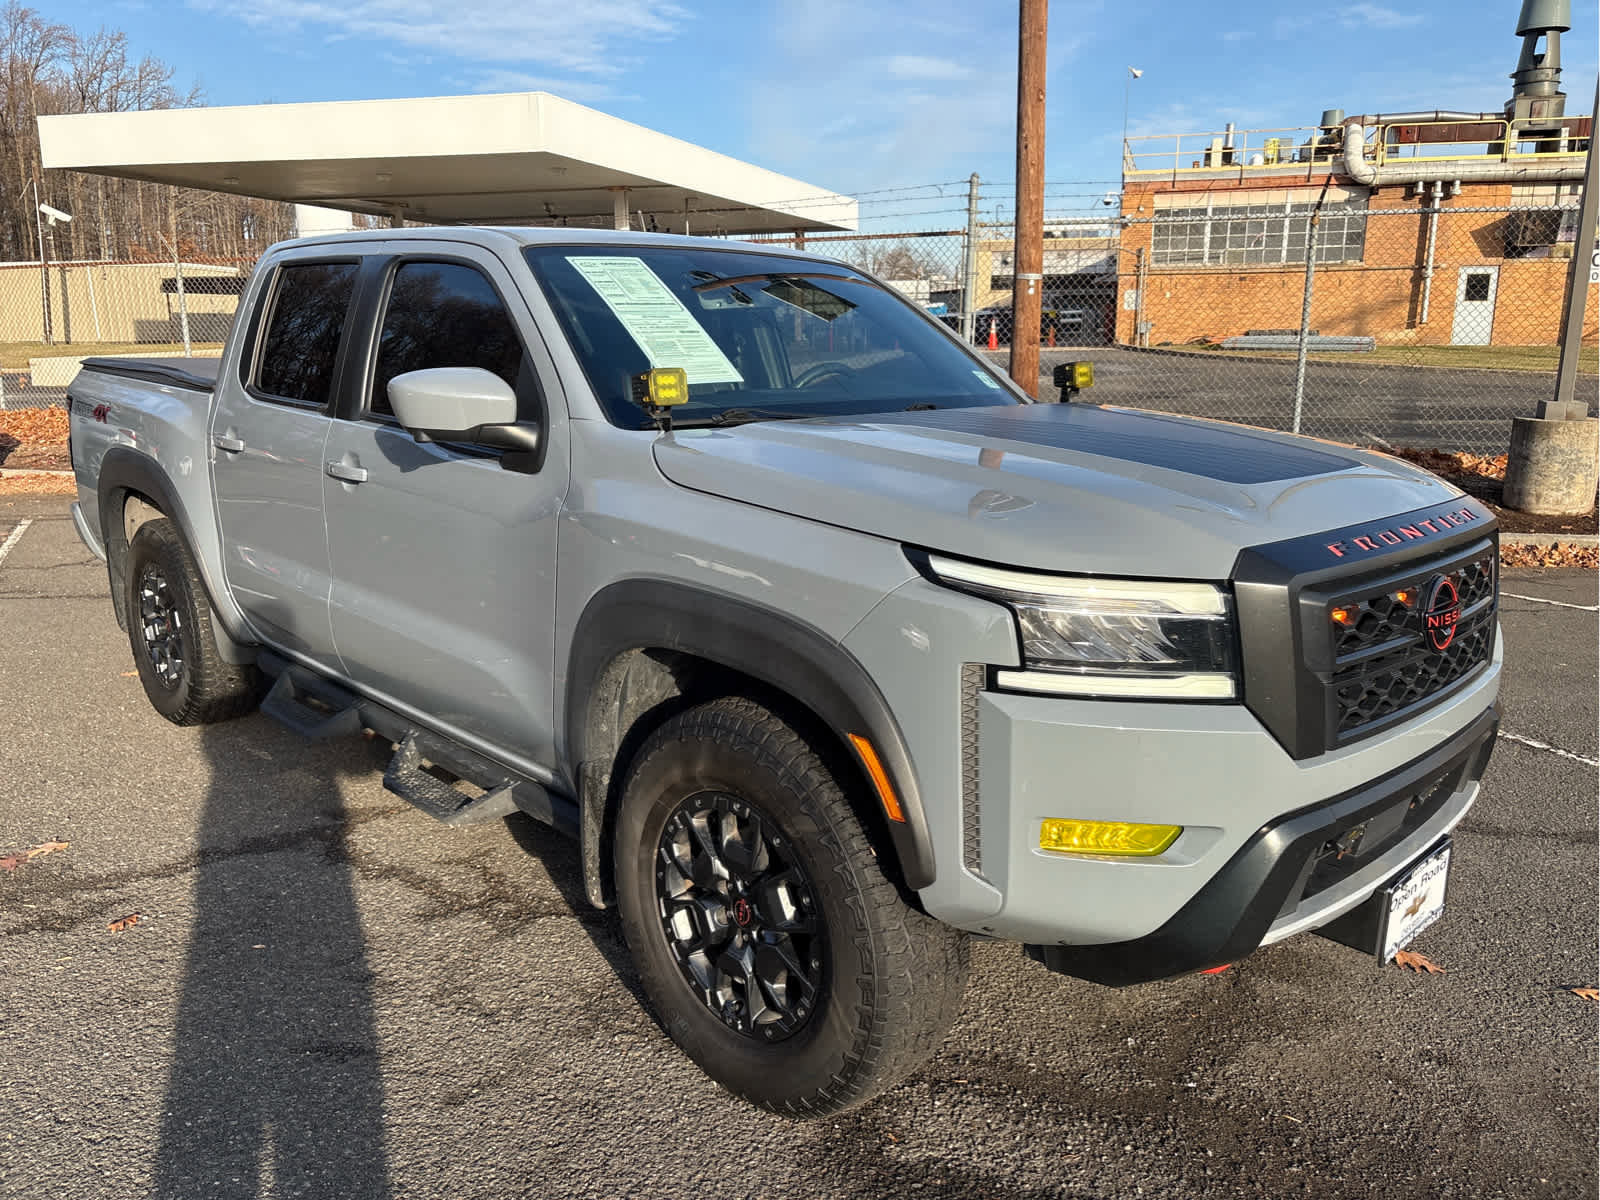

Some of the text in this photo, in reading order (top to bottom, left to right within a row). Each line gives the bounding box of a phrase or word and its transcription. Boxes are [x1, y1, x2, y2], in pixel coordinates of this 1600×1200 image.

[1327, 507, 1479, 557] FRONTIER
[1427, 608, 1461, 628] NISS
[1390, 883, 1418, 912] Open
[1420, 860, 1447, 886] Road
